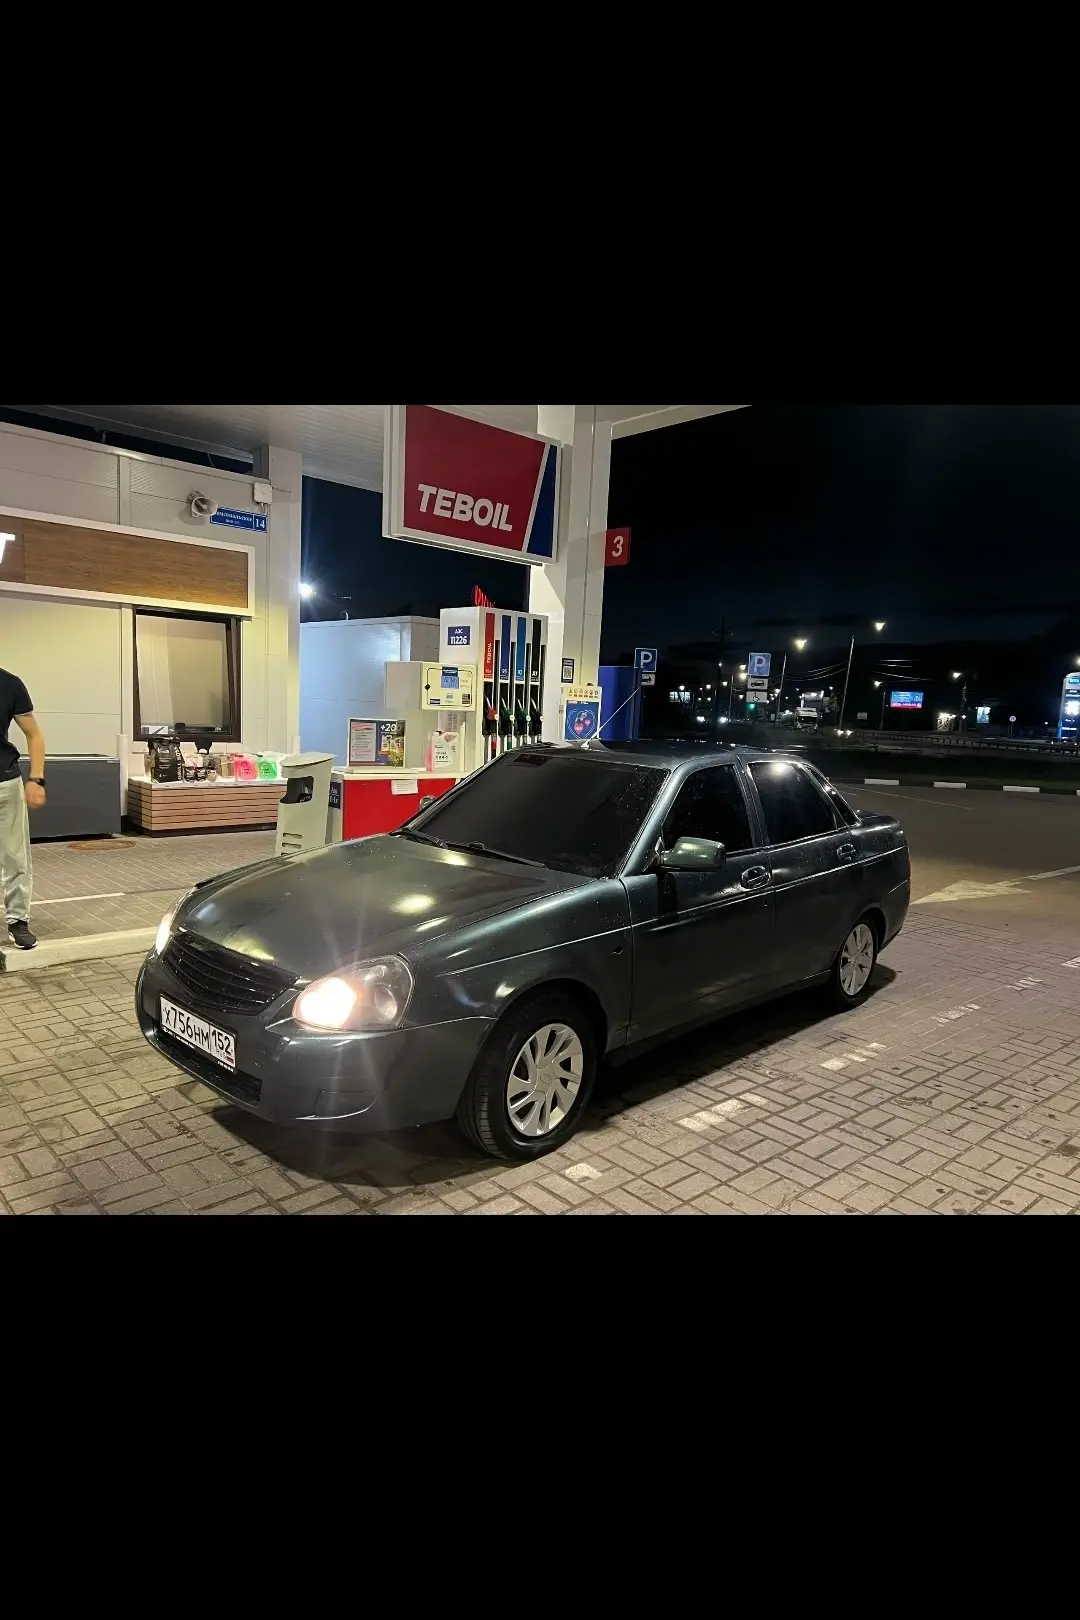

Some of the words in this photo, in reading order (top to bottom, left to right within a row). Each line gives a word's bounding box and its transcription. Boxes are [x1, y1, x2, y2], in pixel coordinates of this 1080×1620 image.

[417, 483, 513, 532] TEBOIL
[255, 518, 265, 529] 14
[611, 535, 624, 558] 3
[450, 635, 468, 645] 11226
[640, 650, 653, 668] P
[753, 655, 766, 673] P
[211, 1029, 232, 1055] 152
